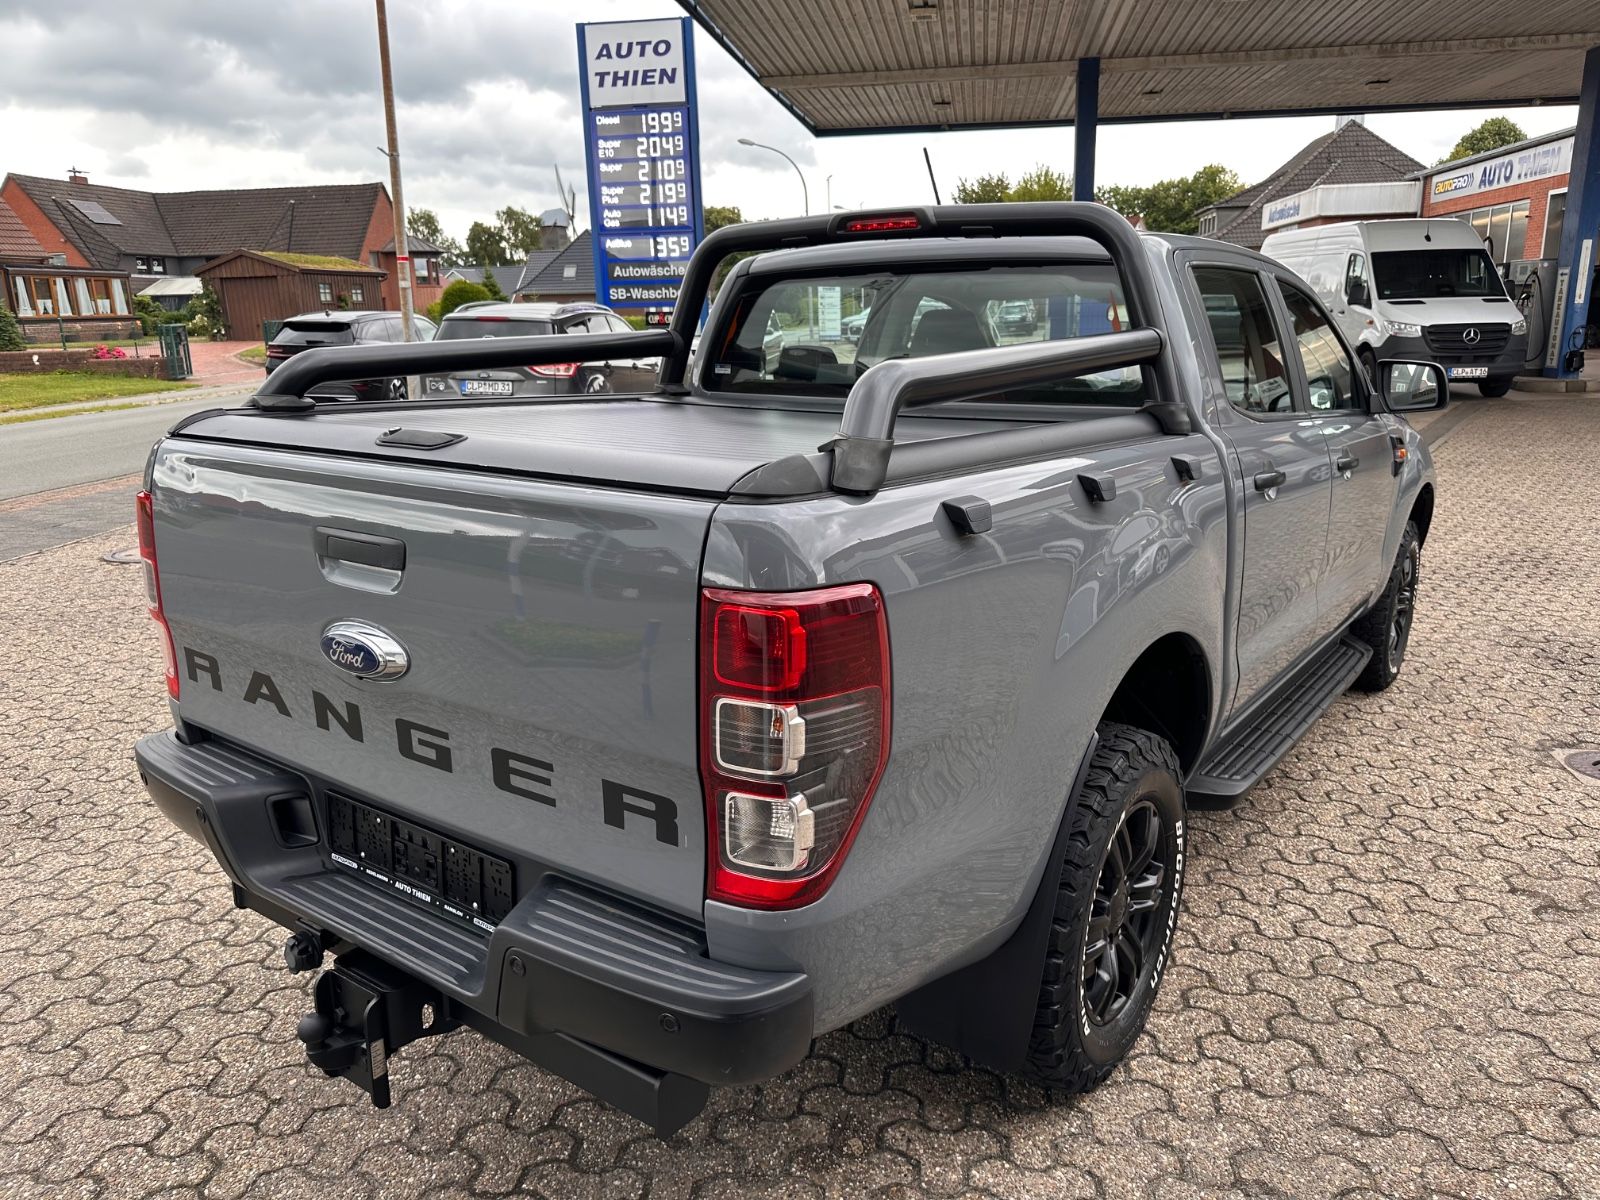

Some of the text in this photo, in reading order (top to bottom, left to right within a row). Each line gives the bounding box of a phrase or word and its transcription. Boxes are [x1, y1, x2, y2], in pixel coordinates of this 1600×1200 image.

[595, 39, 672, 60] AUTO
[594, 67, 677, 88] THIEN
[598, 149, 615, 158] E10
[600, 163, 623, 173] Super
[1479, 146, 1562, 189] AUTO THIEN
[601, 186, 624, 195] Super
[602, 195, 619, 204] Plus
[603, 209, 621, 218] Auto
[603, 218, 620, 227] Gas
[614, 264, 686, 278] Autowäsche
[500, 381, 511, 391] 31
[329, 639, 365, 668] Ford
[183, 646, 679, 847] RANGER
[395, 881, 411, 894] AUTO
[412, 888, 431, 903] THIEN
